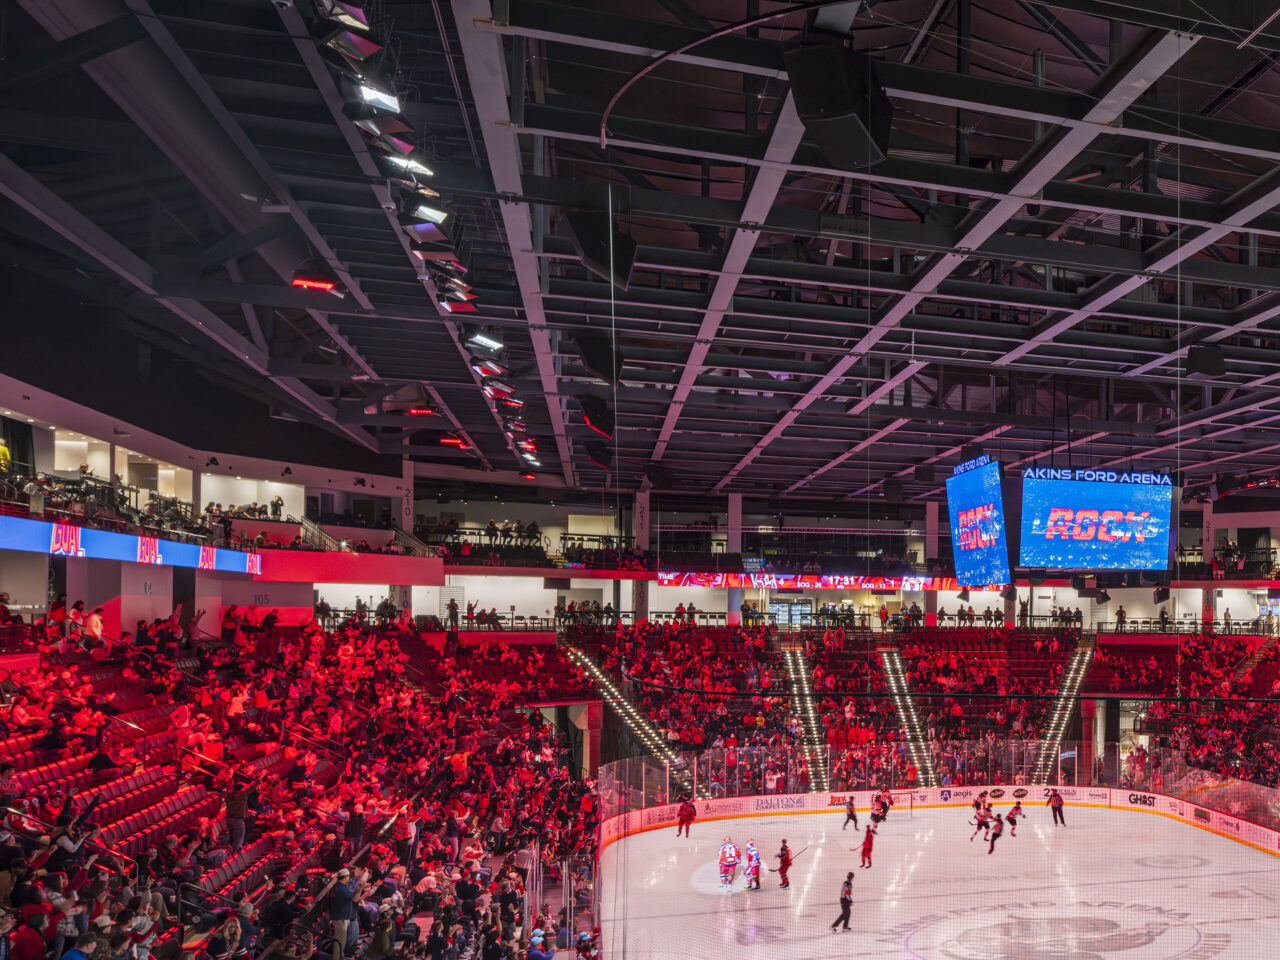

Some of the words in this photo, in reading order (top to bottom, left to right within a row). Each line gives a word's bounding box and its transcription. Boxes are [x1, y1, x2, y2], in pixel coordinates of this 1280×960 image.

[1023, 467, 1072, 480] AKINS
[1075, 470, 1118, 482] FORD
[1119, 472, 1173, 485] ARENA
[1045, 507, 1151, 542] ROCK
[778, 578, 785, 586] 4
[828, 576, 855, 586] 17:31
[953, 789, 973, 797] aegis
